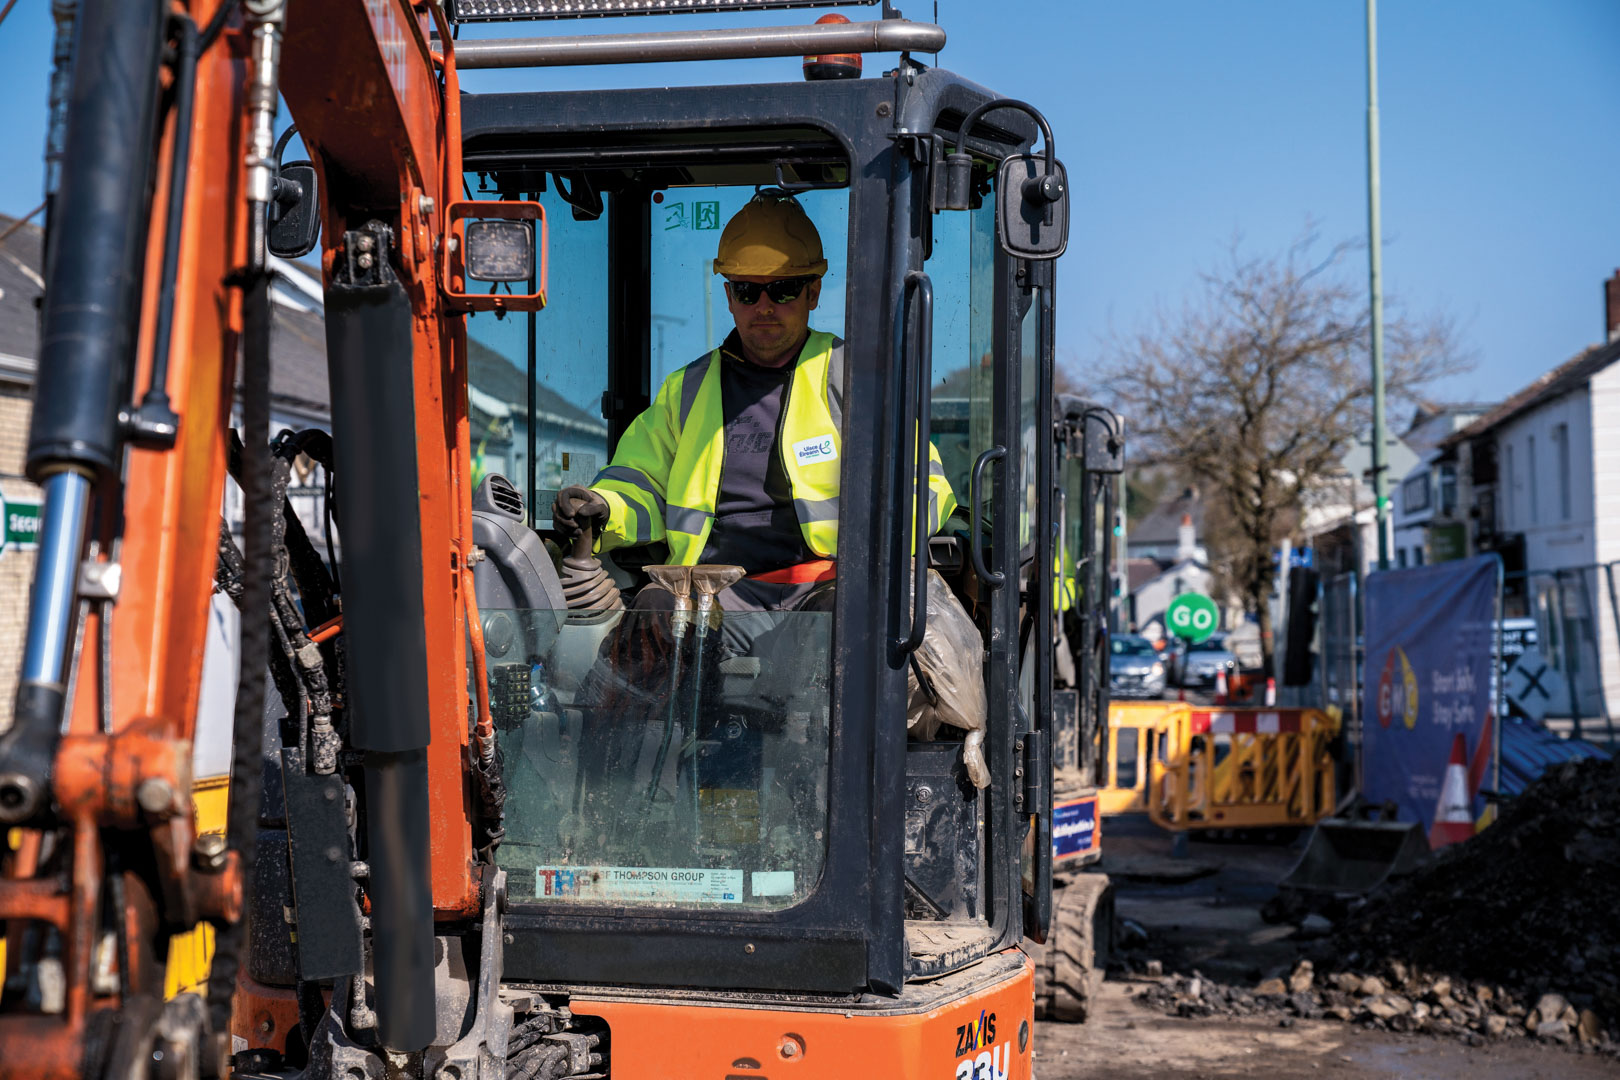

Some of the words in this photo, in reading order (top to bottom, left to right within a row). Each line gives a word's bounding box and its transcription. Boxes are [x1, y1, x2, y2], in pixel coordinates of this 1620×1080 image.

[1172, 604, 1213, 630] GO
[613, 870, 668, 881] THOMPSON
[671, 871, 705, 882] GROUP
[955, 1009, 997, 1059] ZAXIS
